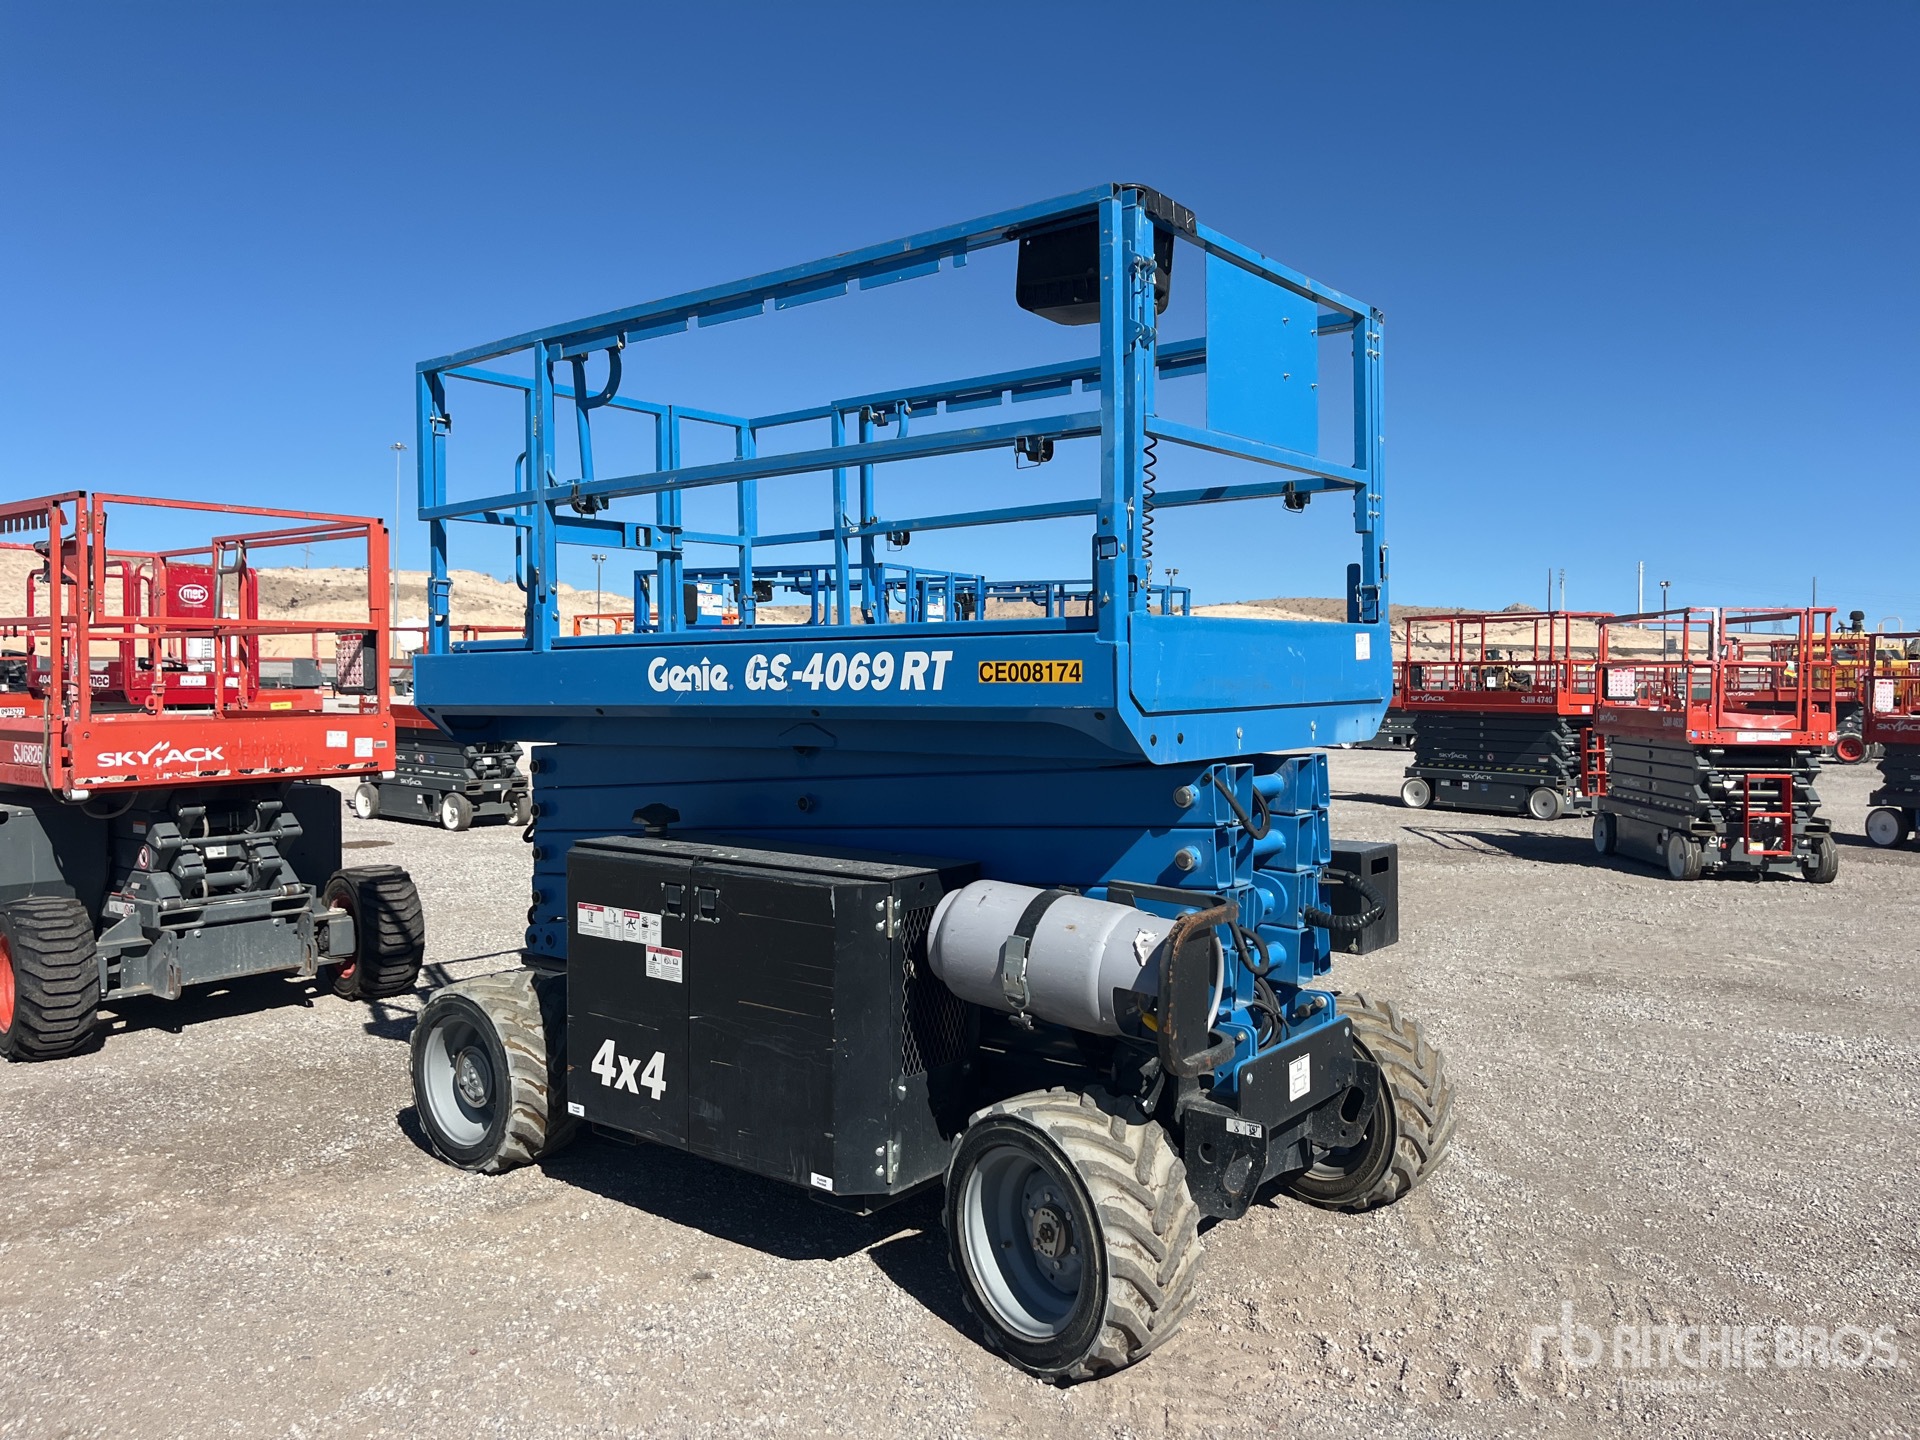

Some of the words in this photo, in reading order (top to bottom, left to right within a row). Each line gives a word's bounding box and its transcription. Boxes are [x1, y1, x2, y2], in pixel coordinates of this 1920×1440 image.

[647, 656, 729, 692] Genie
[744, 652, 895, 691] GS-4069
[899, 650, 953, 691] RT
[978, 662, 1082, 682] CE008174
[1410, 693, 1445, 703] SKYJACK
[1536, 695, 1553, 704] 4740
[97, 741, 225, 768] SKYJACK
[591, 1038, 667, 1101] 4x4
